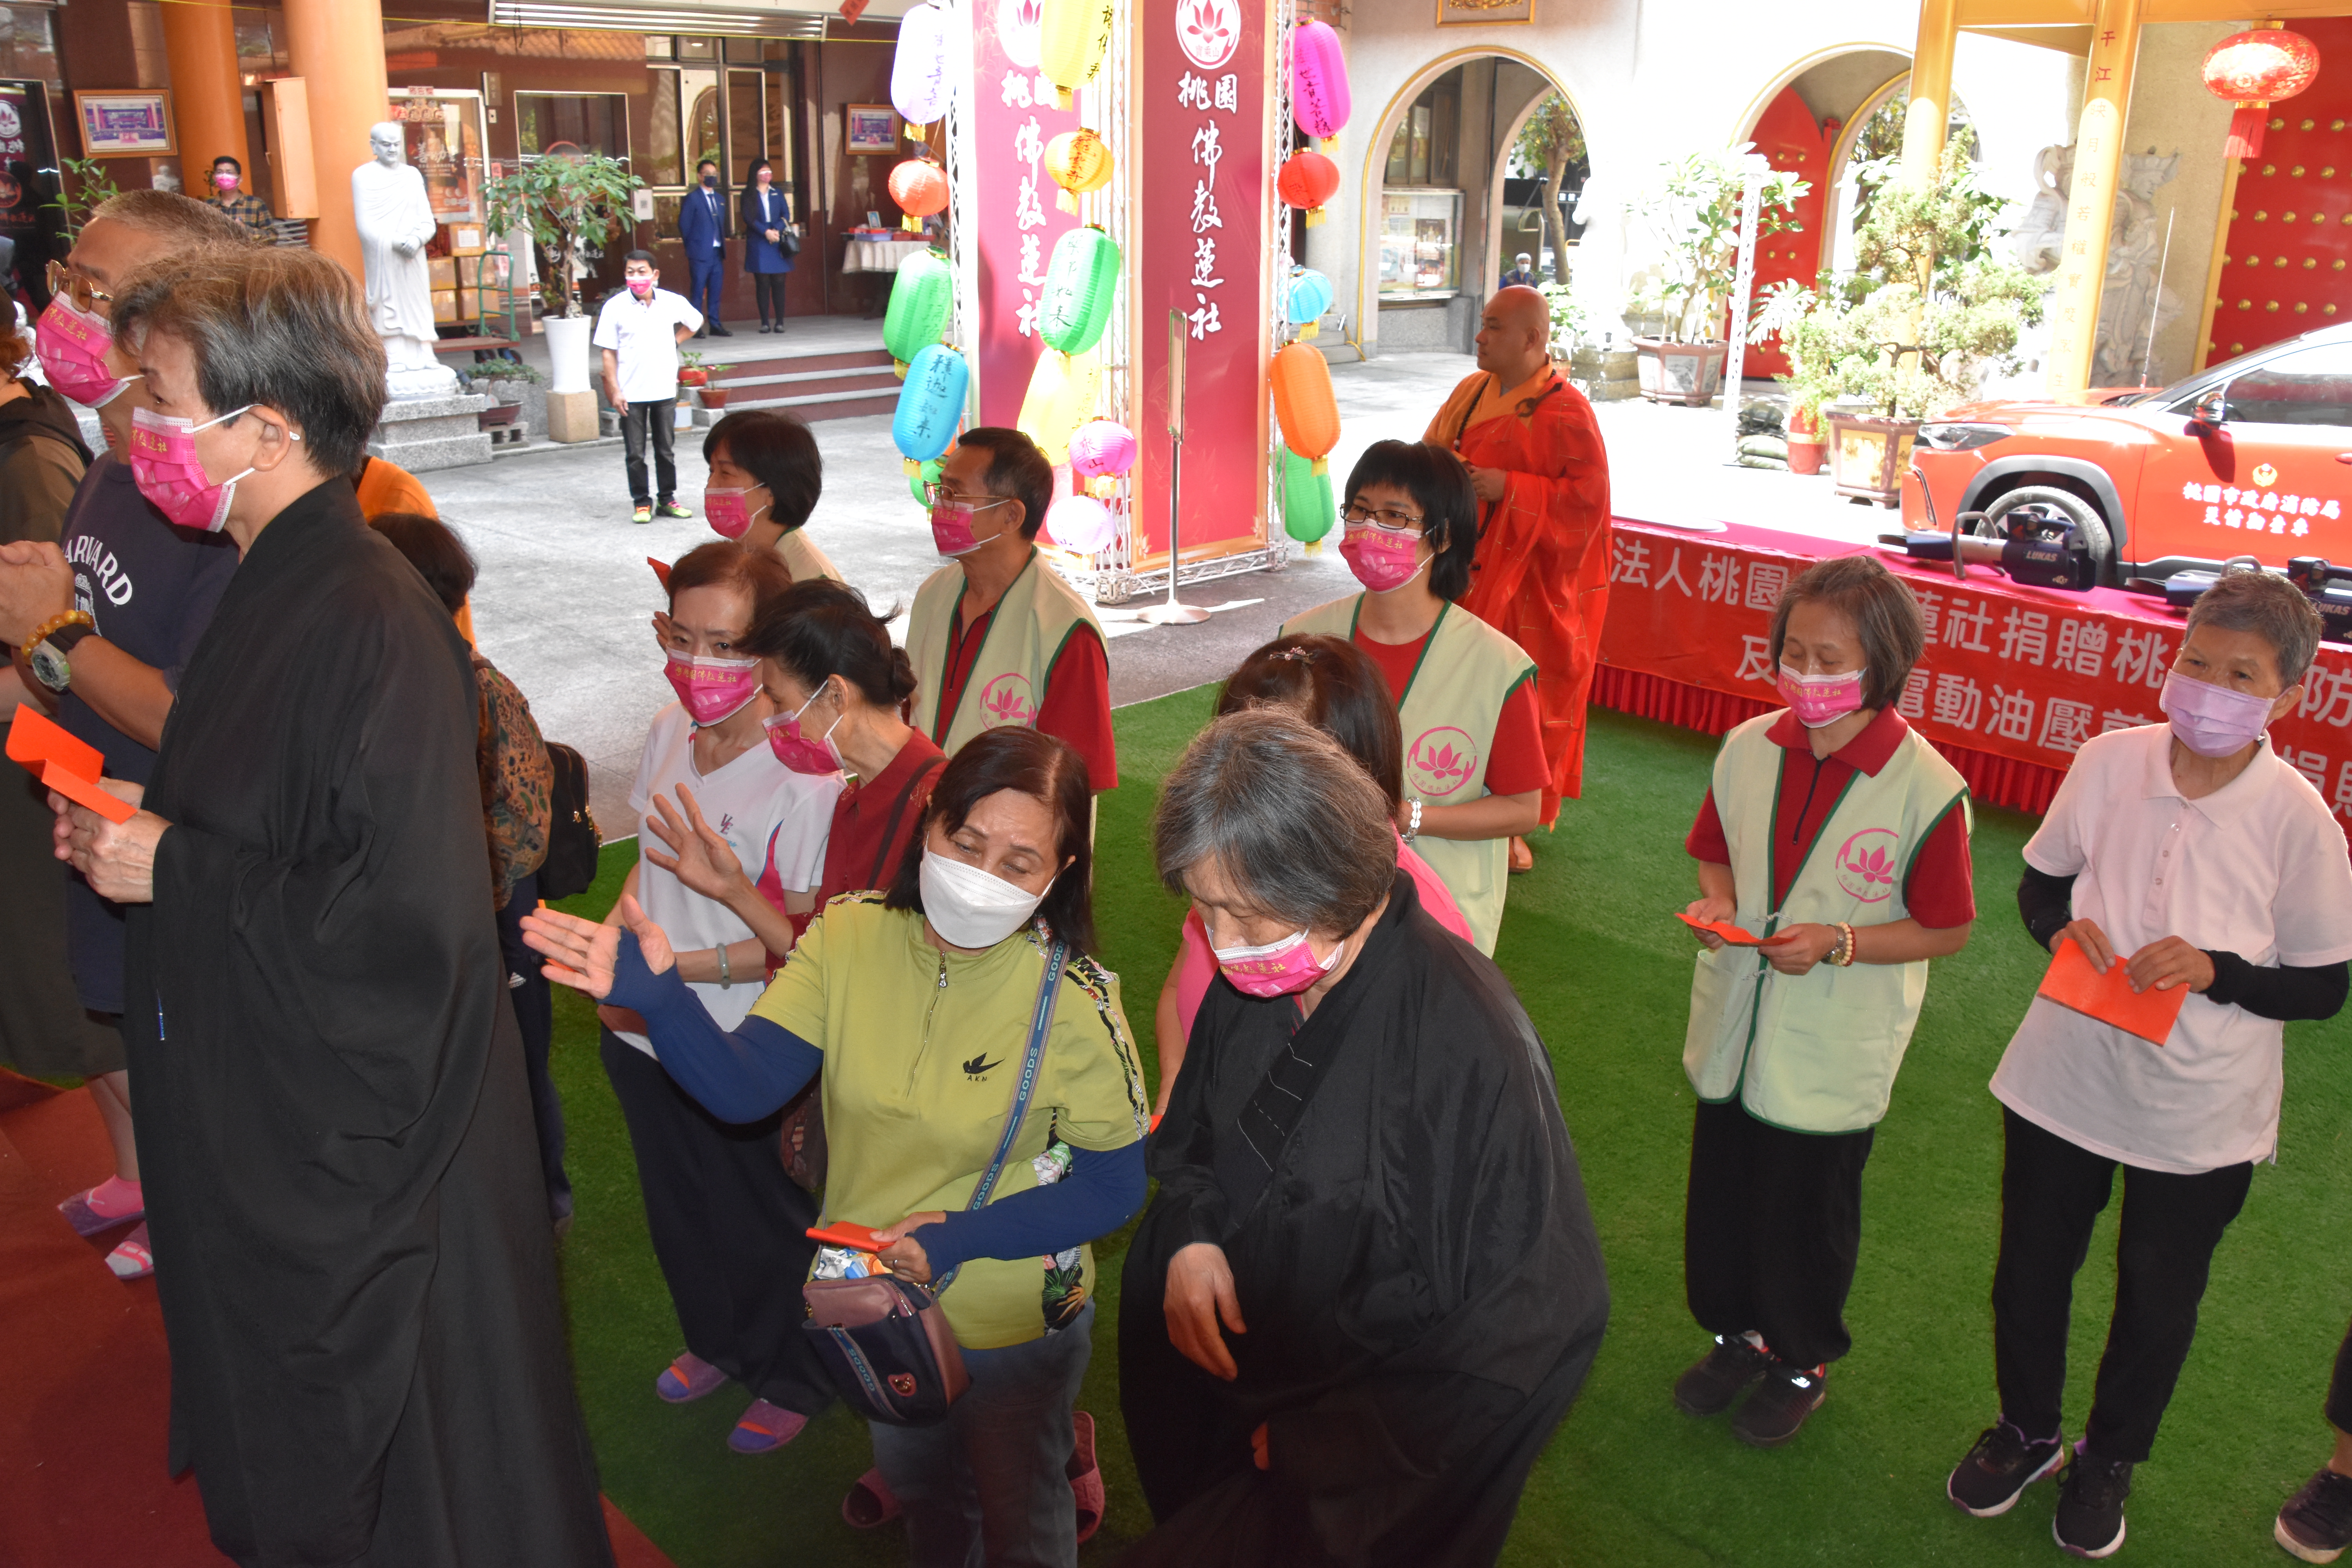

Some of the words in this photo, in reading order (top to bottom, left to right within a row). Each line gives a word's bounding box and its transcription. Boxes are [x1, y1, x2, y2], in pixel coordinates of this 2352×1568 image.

[1178, 71, 1238, 114] 桃園
[1188, 120, 1224, 340] 佛教蓮社
[62, 535, 132, 605] ARVARD
[2026, 550, 2058, 562] LUKAS
[1019, 1047, 1038, 1101] GOODS
[973, 1163, 999, 1210] GOODS
[848, 1348, 875, 1392] GOODS
